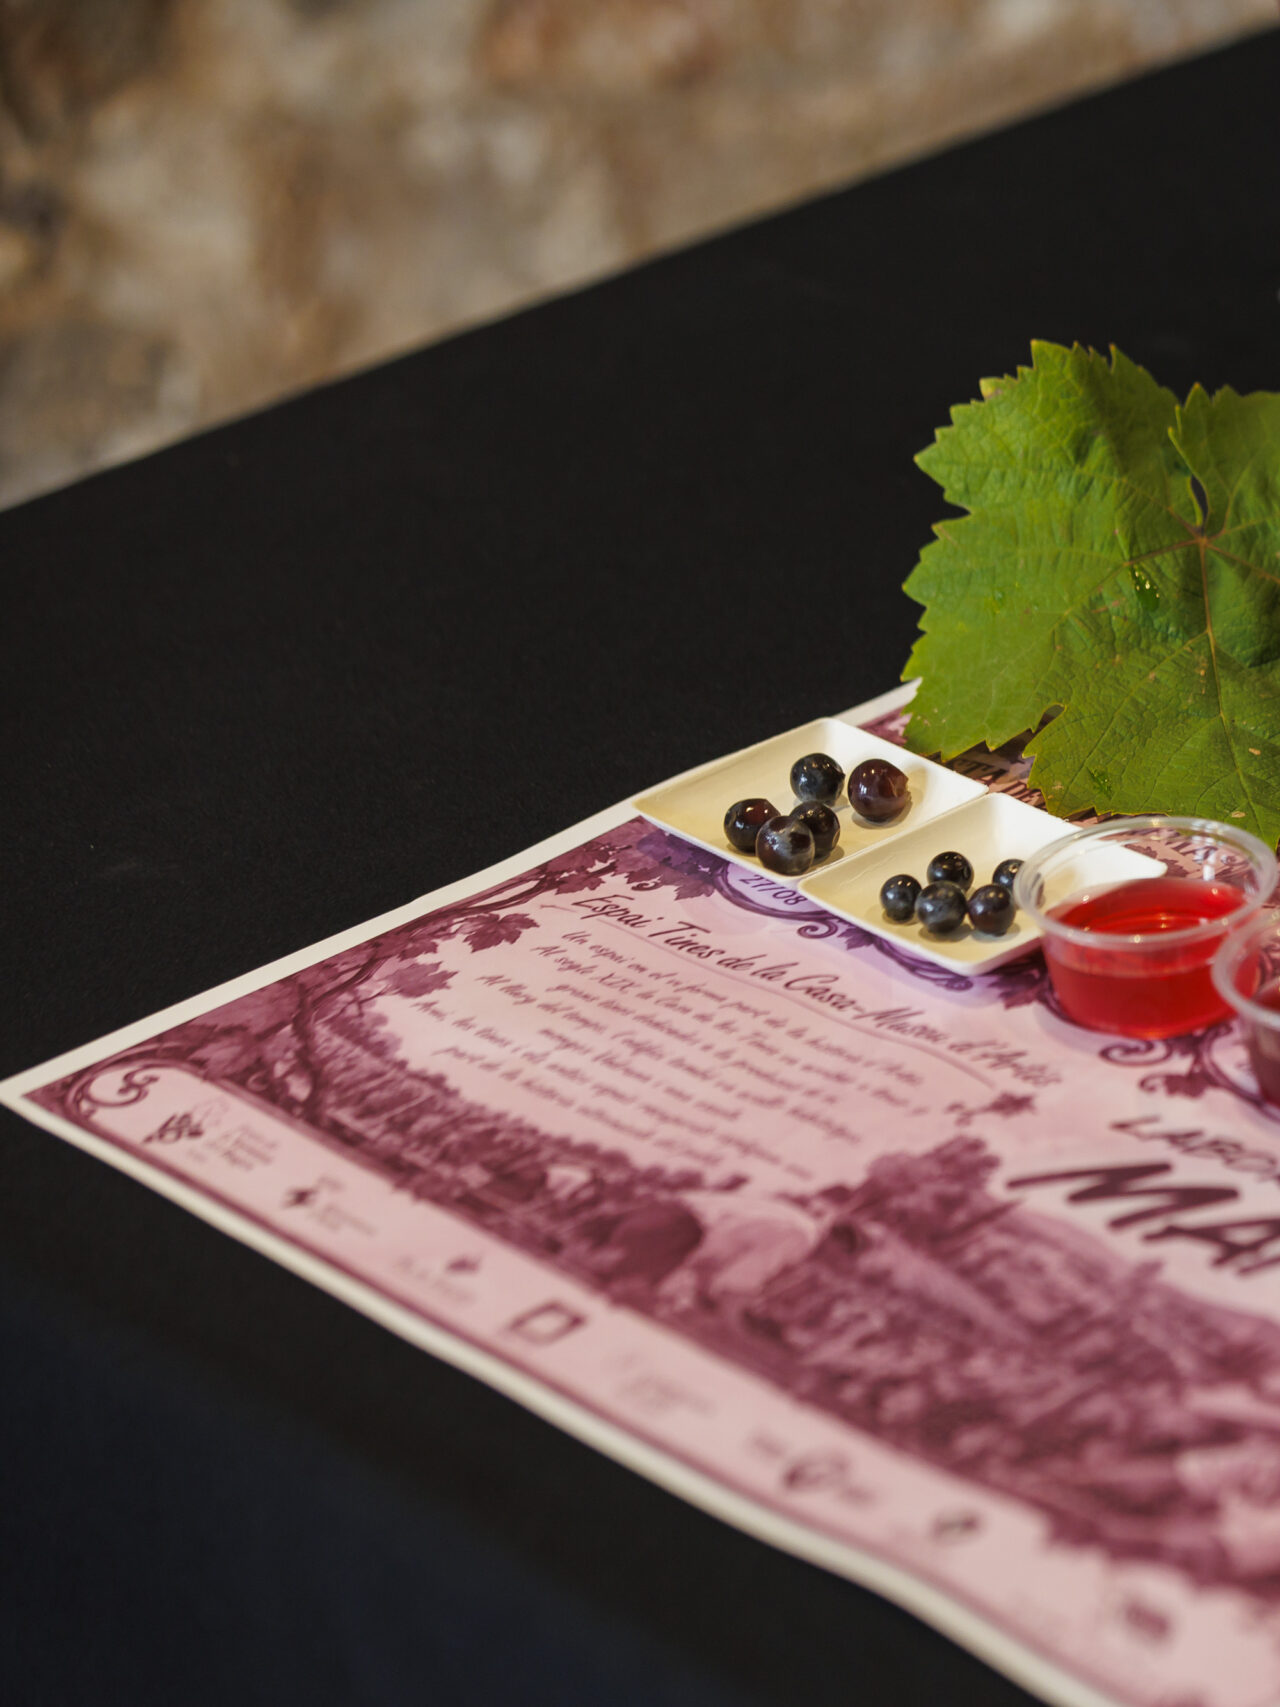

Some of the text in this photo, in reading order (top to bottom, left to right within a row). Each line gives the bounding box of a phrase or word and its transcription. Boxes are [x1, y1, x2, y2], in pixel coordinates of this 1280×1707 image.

[738, 873, 808, 906] 27/08
[531, 944, 567, 957] Al
[552, 956, 597, 975] segle
[559, 930, 591, 945] Un
[586, 943, 634, 964] espai
[571, 893, 664, 928] Espai
[647, 920, 726, 959] Tines
[716, 953, 767, 970] de
[750, 961, 799, 981] la
[783, 973, 948, 1043] Casa-Museu
